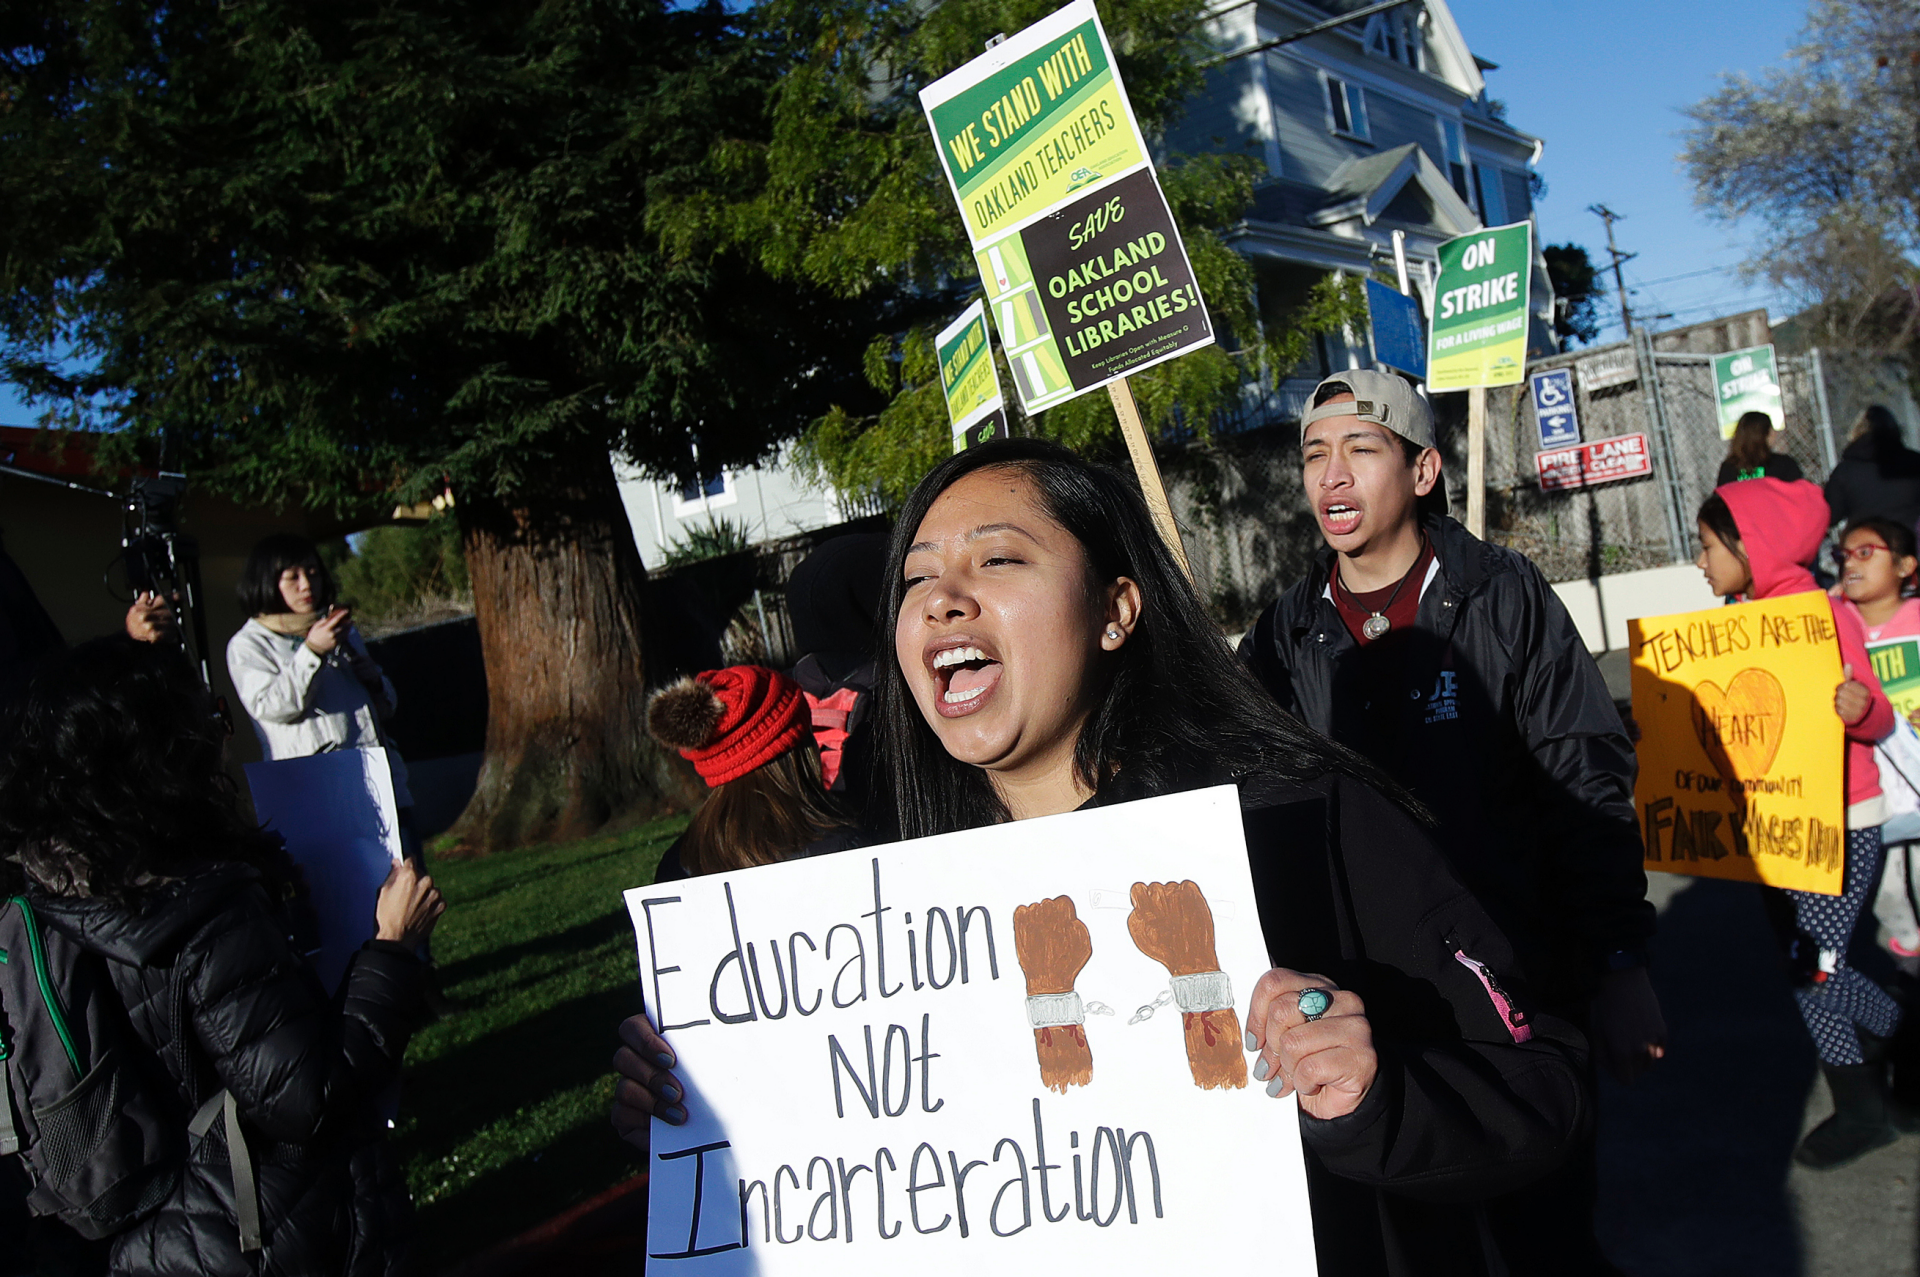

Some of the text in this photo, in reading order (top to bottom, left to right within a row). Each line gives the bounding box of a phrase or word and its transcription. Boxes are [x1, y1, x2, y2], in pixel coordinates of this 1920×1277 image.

[949, 33, 1093, 174] WE STAND WITH
[974, 100, 1115, 229] OAKLAND TEACHERS
[1068, 195, 1125, 251] SAVE
[1048, 231, 1167, 299] OAKLAND
[1462, 238, 1495, 271] ON
[1064, 283, 1198, 358] LIBRARIES!
[1066, 265, 1169, 324] SCHOOL
[1440, 271, 1518, 319] STRIKE
[1091, 359, 1106, 370] Keep
[1105, 350, 1129, 364] Libraries
[1128, 343, 1145, 355] Open
[1144, 338, 1158, 348] with
[1157, 328, 1182, 343] Measure
[1108, 341, 1178, 373] Funds Allocated Equitably
[1436, 316, 1523, 351] FOR A LIVING WAGE
[1541, 449, 1582, 470] FIRE
[1589, 437, 1642, 460] LANE
[1640, 612, 1837, 675] TEACHERS ARE THE
[1869, 645, 1906, 682] ITH
[1701, 706, 1772, 748] HEART
[1645, 796, 1729, 861] FAIR
[1728, 799, 1803, 860] WAGES
[642, 857, 1000, 1035] Education
[648, 1098, 1164, 1258] Incarceration
